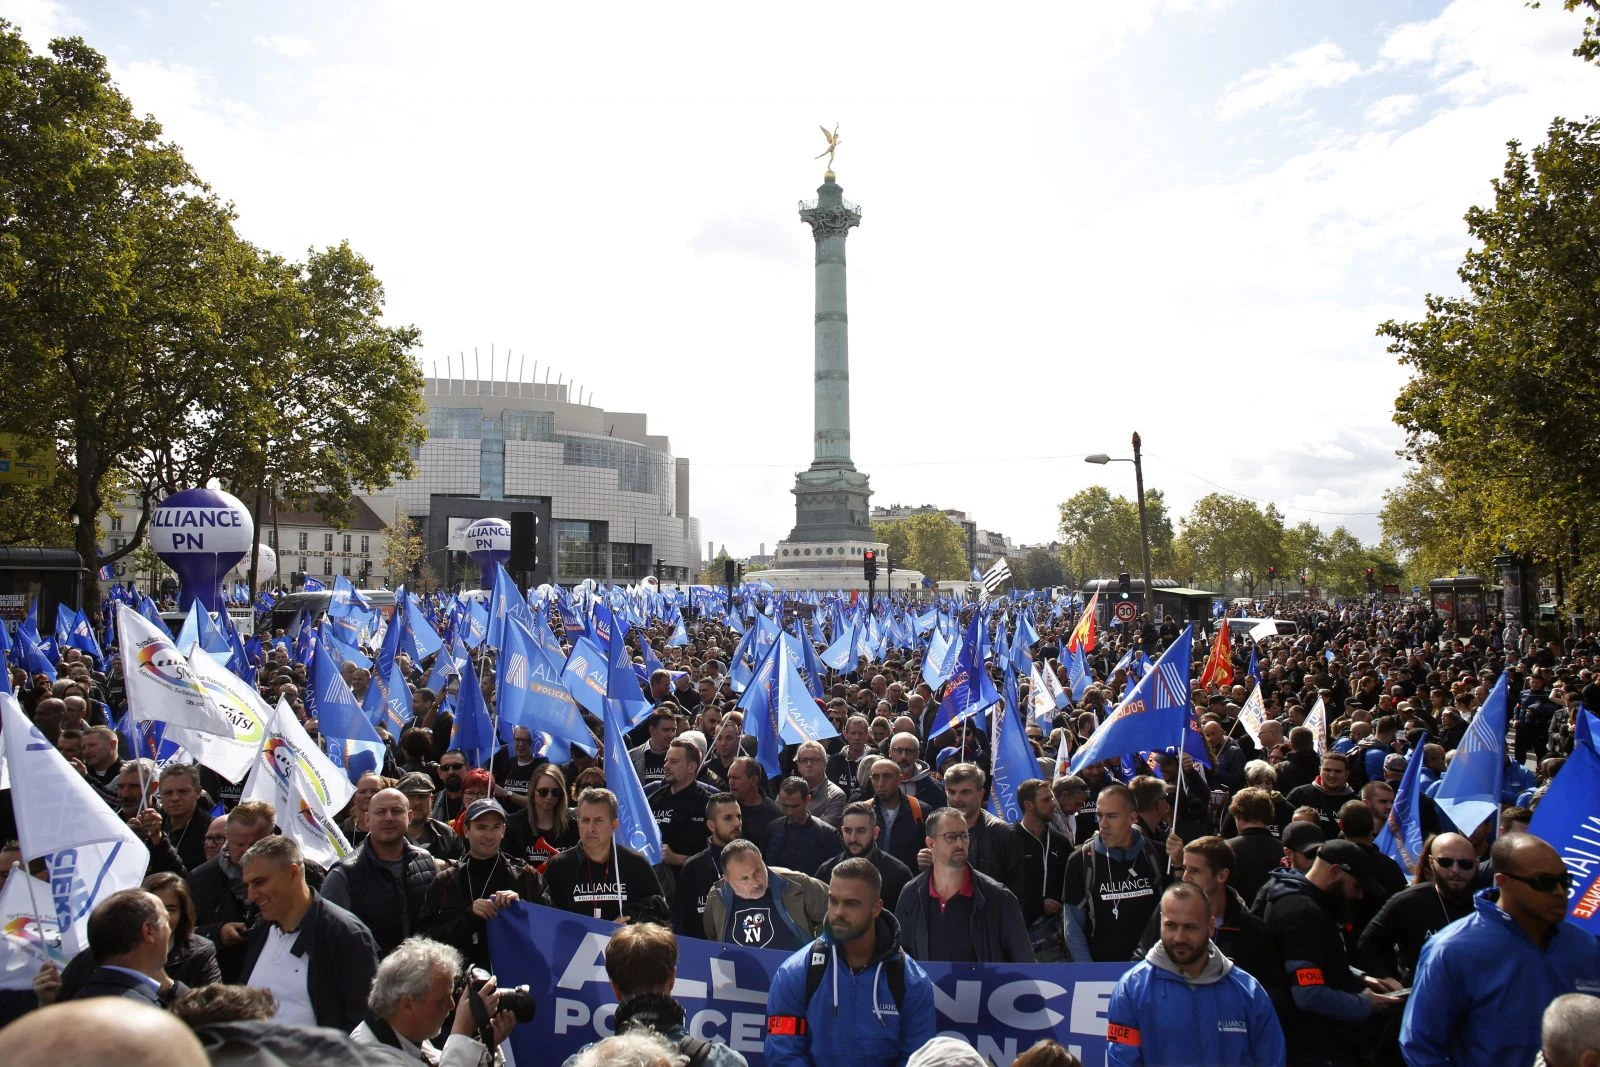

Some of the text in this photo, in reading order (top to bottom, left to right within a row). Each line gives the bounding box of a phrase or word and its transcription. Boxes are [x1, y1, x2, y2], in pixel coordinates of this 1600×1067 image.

[149, 511, 241, 528] ALLIANCE
[172, 533, 204, 550] PN
[476, 539, 492, 549] PN
[280, 549, 325, 558] GRANDES
[1120, 608, 1131, 616] 30
[537, 685, 564, 699] POLICE
[573, 883, 627, 895] ALLIANCE
[1100, 878, 1151, 893] ALLIANCE
[743, 927, 761, 943] XV
